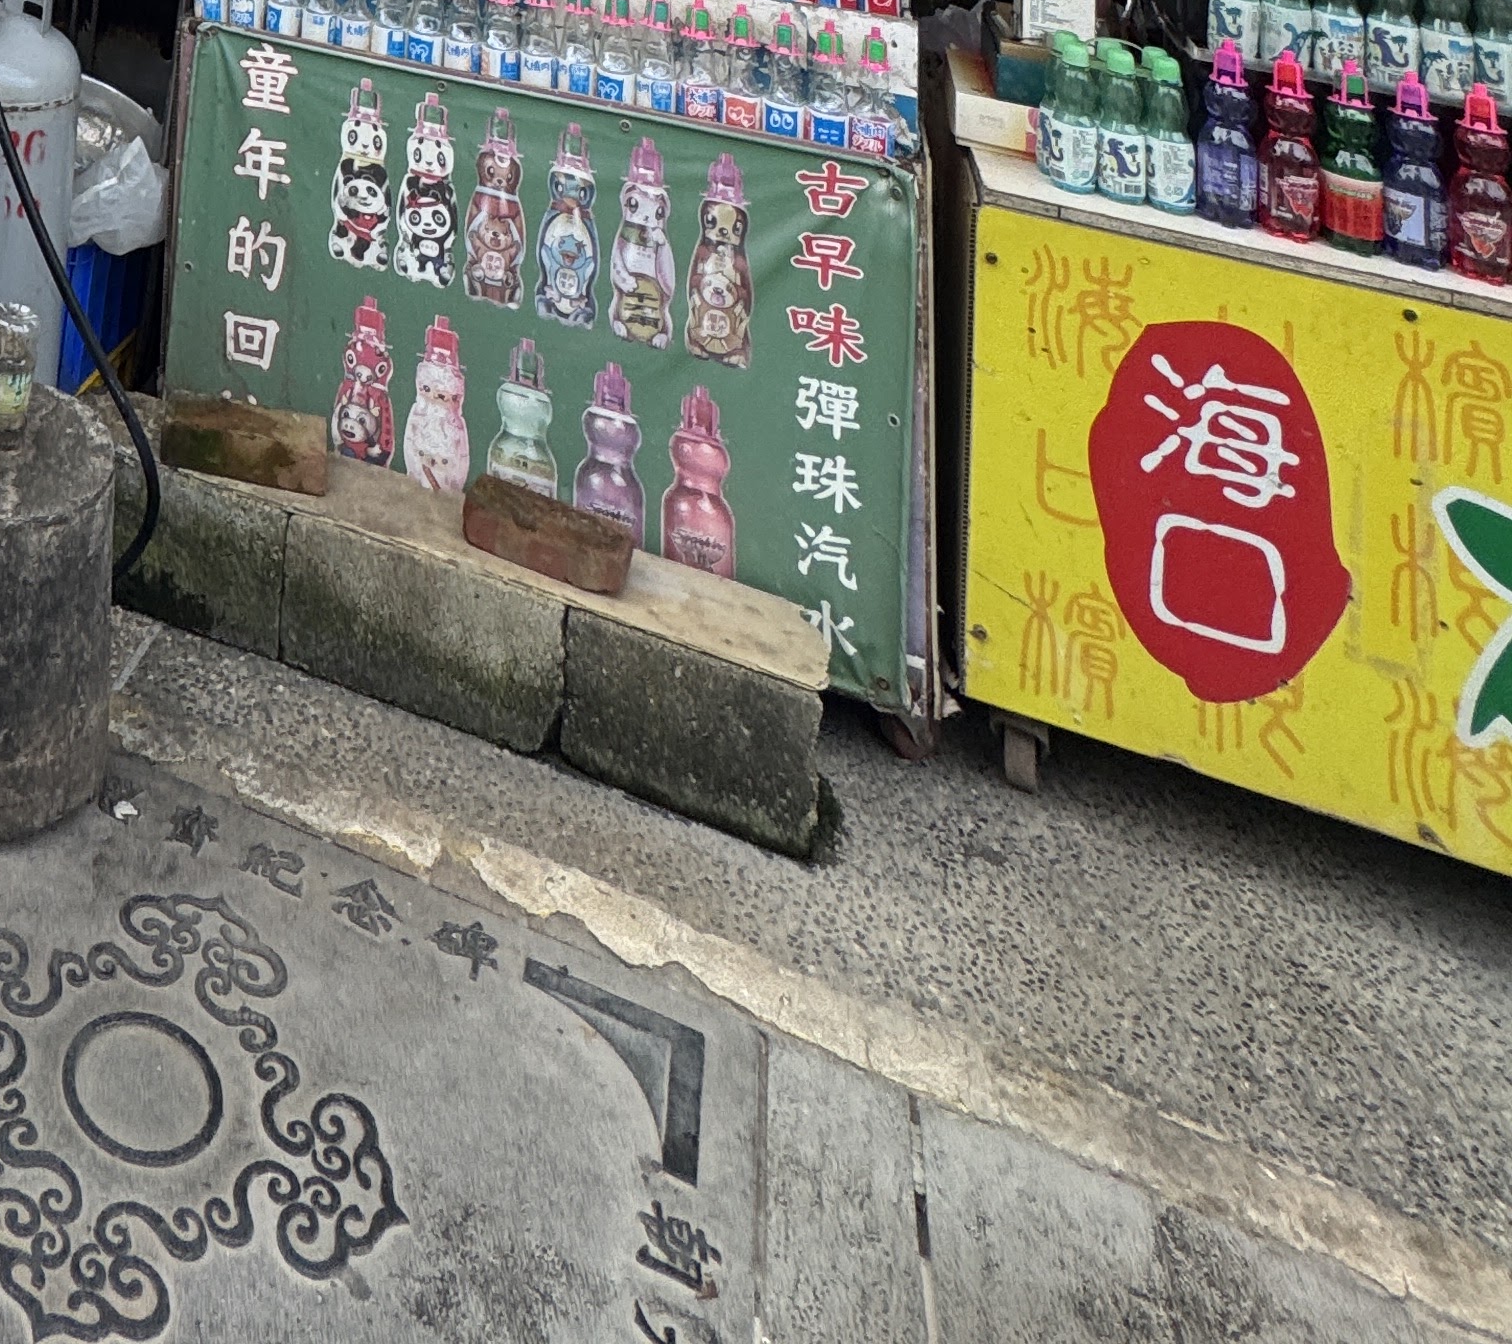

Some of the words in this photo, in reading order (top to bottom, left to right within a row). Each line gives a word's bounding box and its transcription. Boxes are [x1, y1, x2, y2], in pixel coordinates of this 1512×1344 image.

[223, 43, 299, 406] 童年的回
[1141, 353, 1300, 654] 海口
